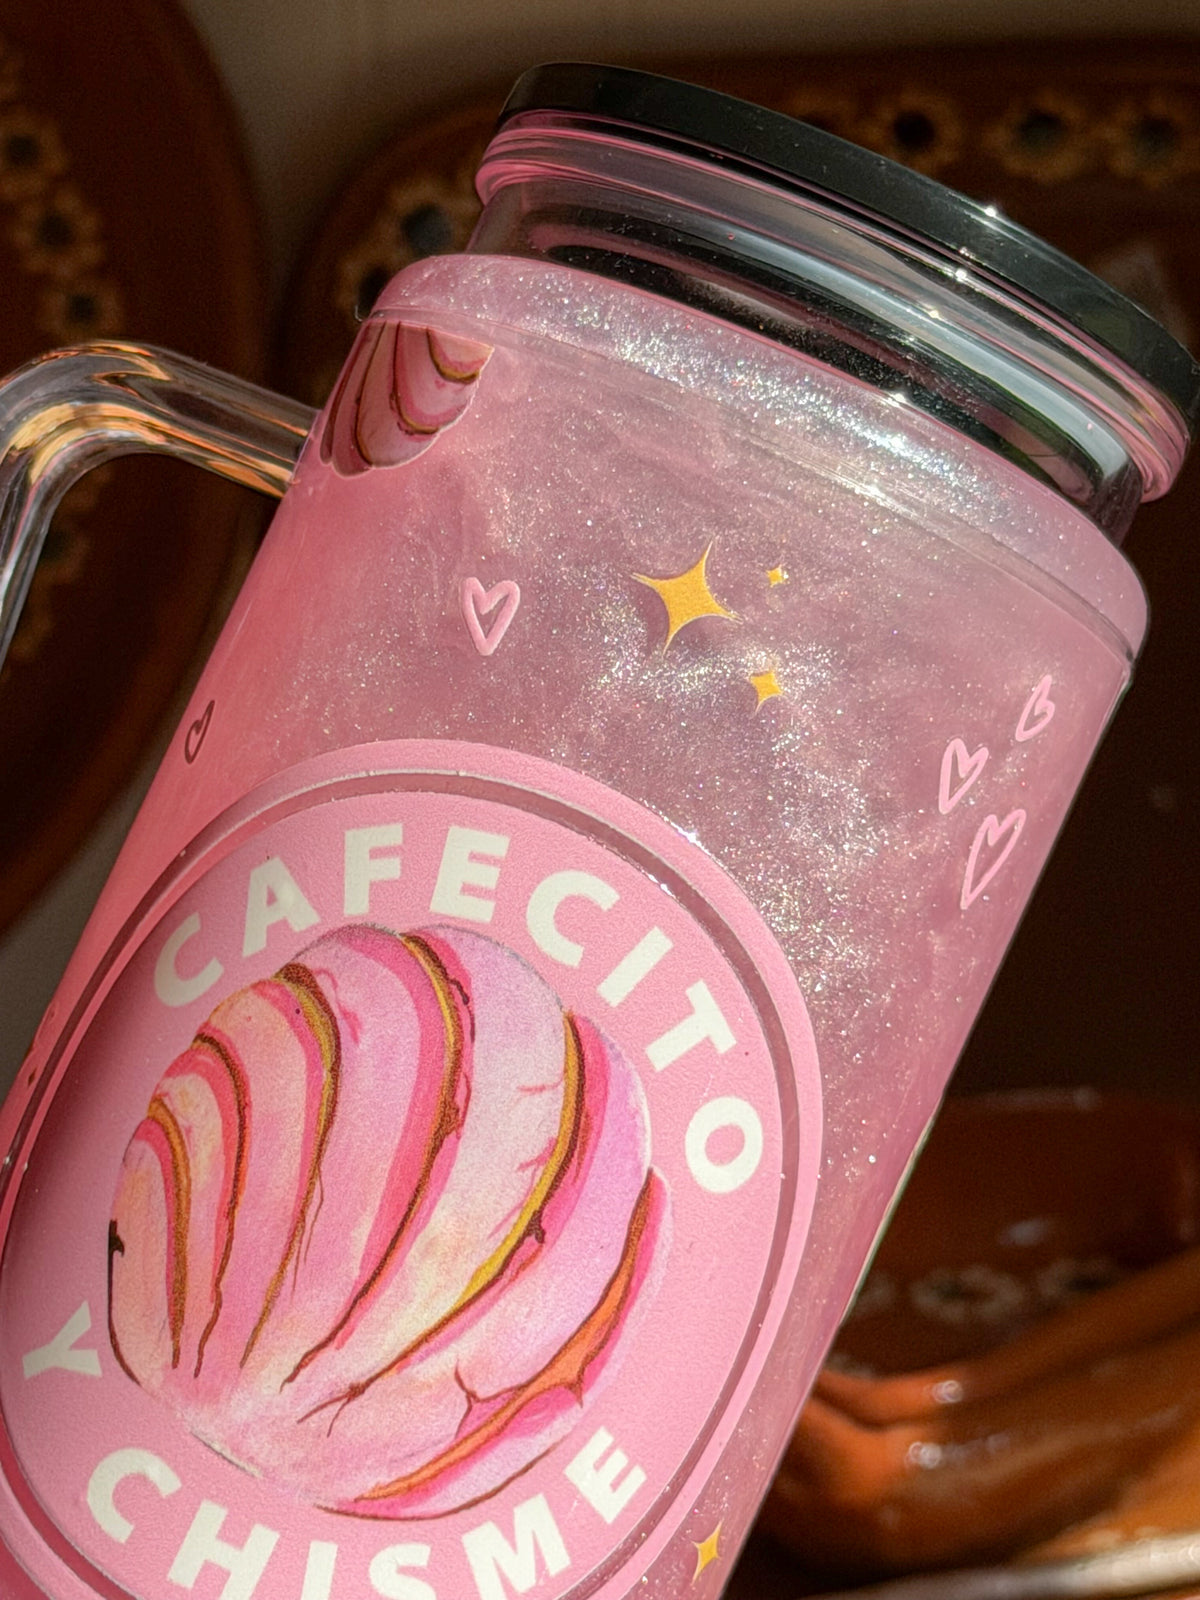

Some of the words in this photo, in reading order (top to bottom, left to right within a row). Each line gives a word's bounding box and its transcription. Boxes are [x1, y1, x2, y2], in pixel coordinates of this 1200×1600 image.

[153, 822, 764, 1194] CAFECITO
[22, 1300, 103, 1380] Y
[86, 1426, 647, 1600] CHISME
